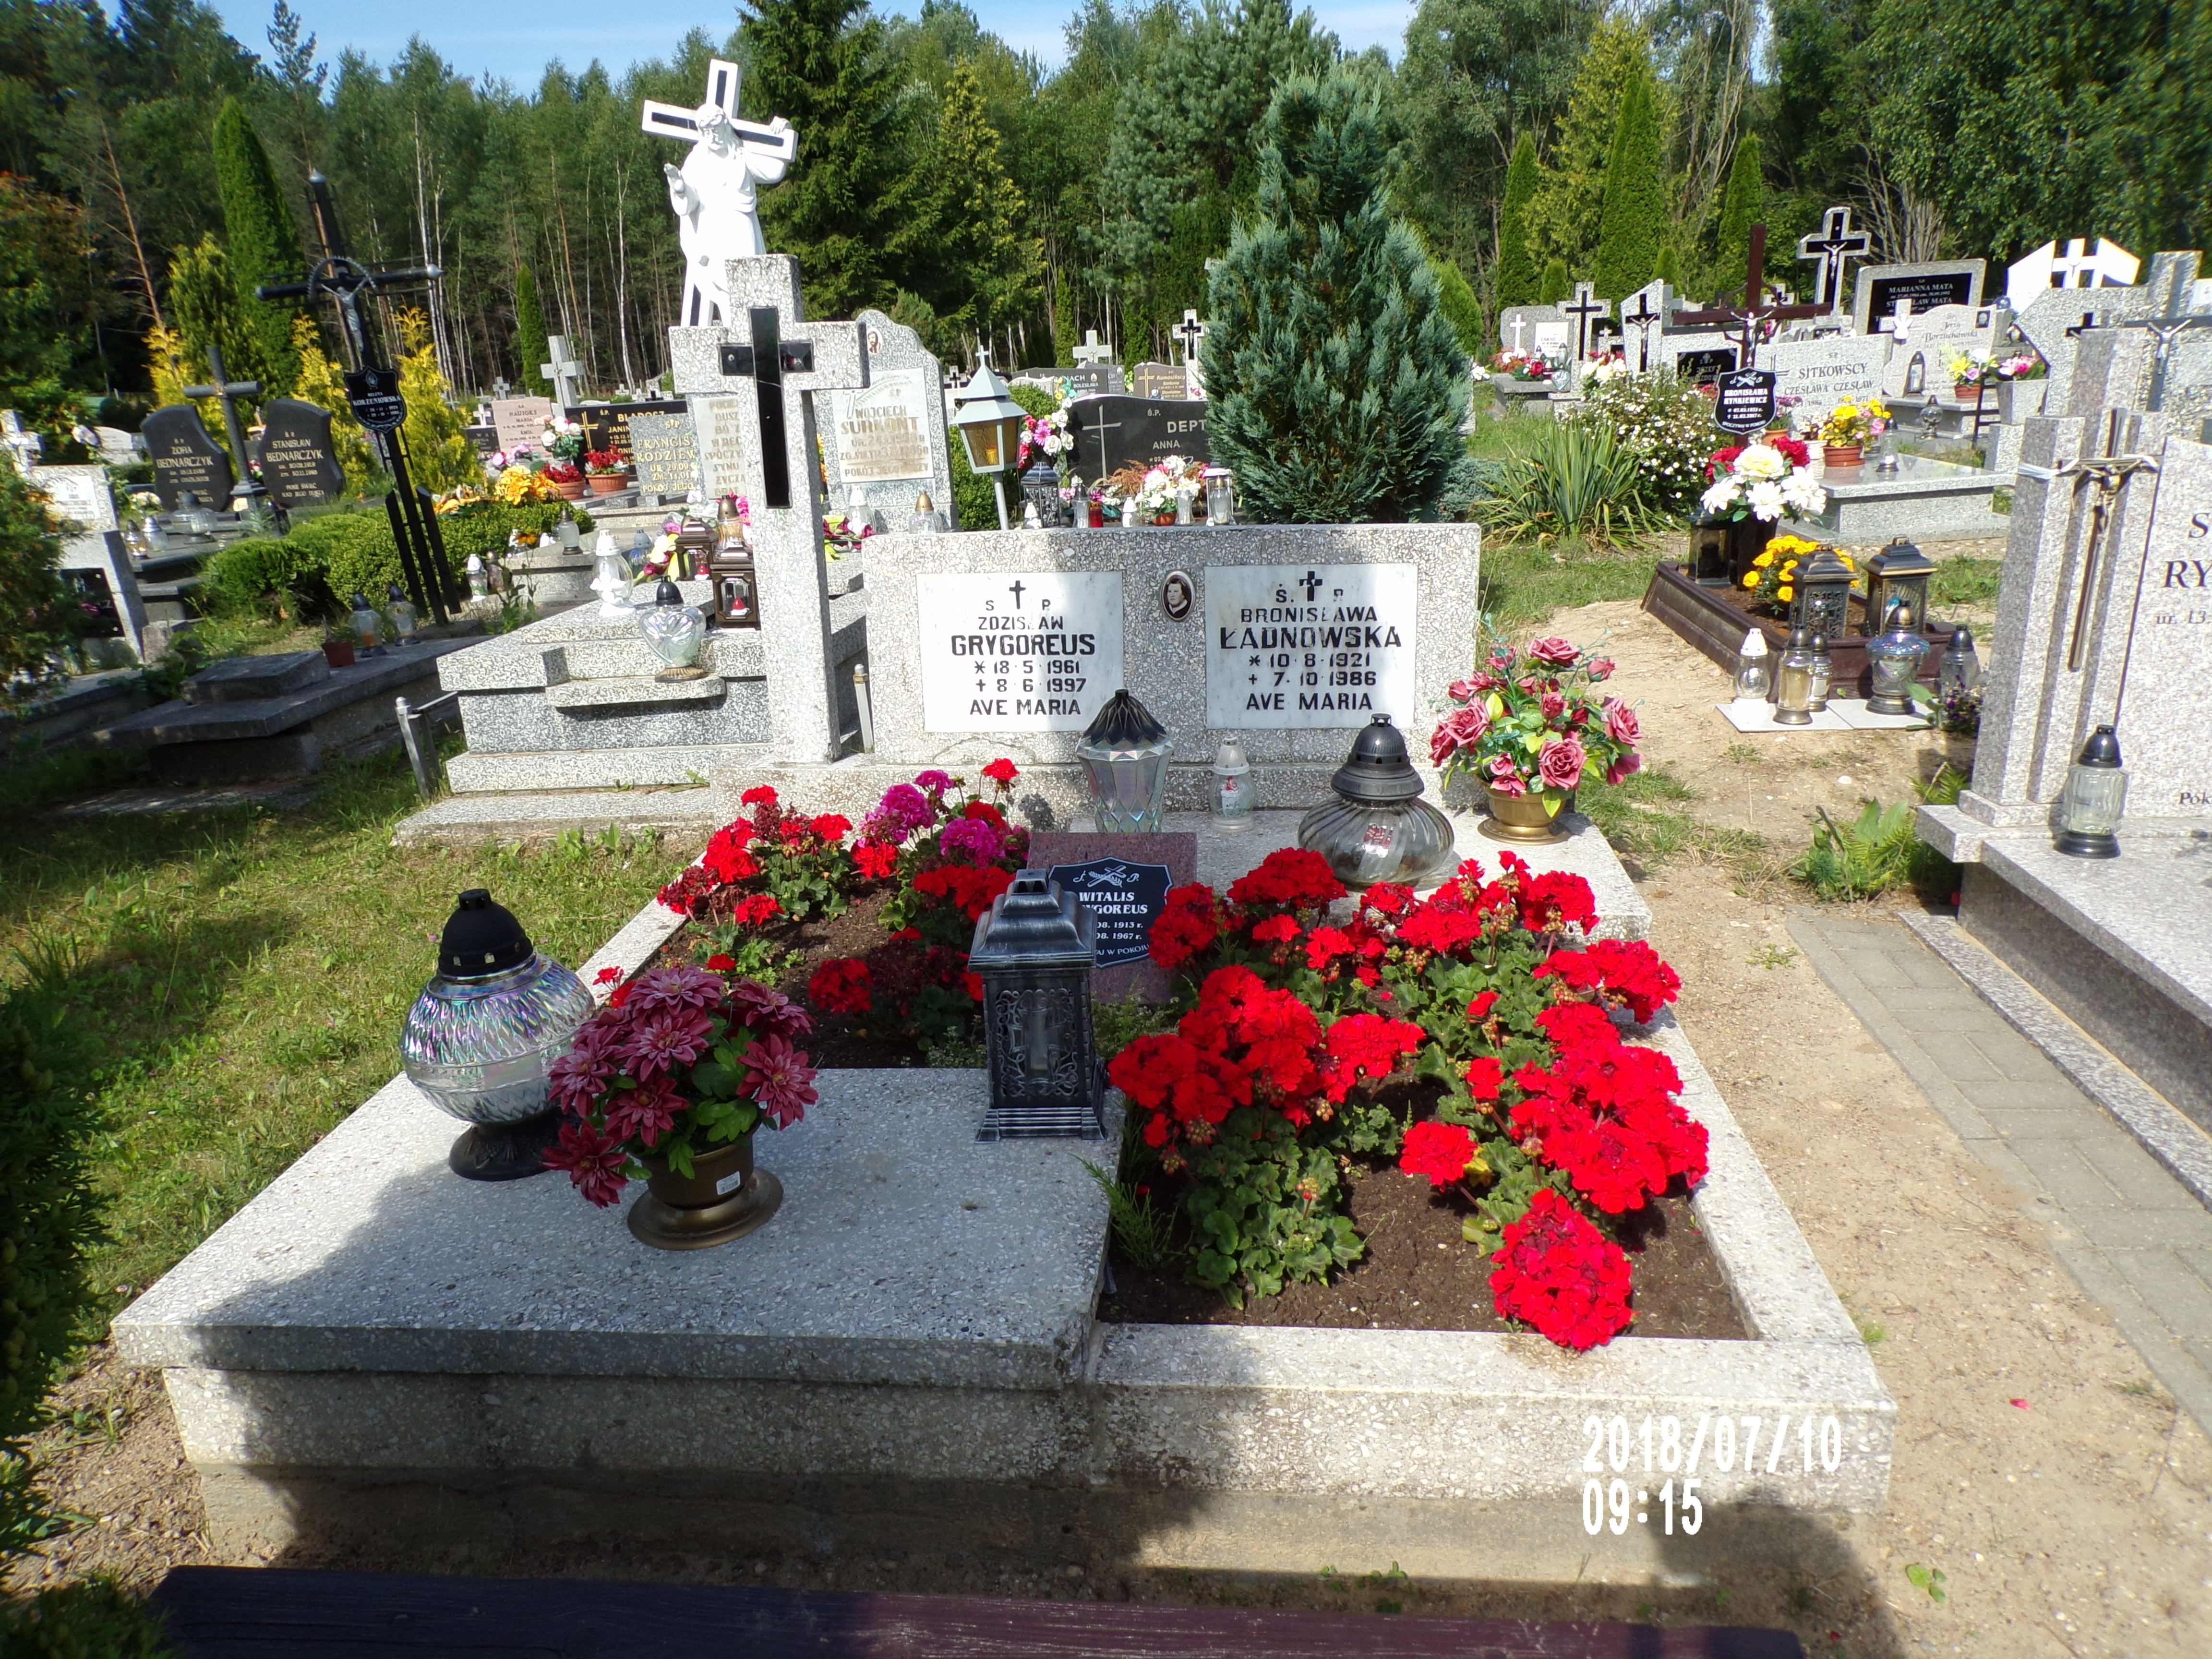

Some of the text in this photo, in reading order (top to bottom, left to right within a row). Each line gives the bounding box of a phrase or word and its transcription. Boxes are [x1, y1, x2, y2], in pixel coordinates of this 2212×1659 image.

[1888, 286, 1930, 294] MARIANNA
[1799, 362, 1867, 379] SITKOWSCY
[1724, 388, 1768, 397] BRONISŁAWA
[352, 395, 401, 406] KORZENIOWSKA
[855, 405, 907, 419] WOJCIECH
[1153, 439, 1180, 450] ANNA
[266, 449, 325, 462] BEDNARCZYK
[156, 456, 214, 469] BEDNARCZYK
[1240, 606, 1378, 623] BRONISŁAWA
[1220, 625, 1402, 649] ŁADNOWSKA
[951, 634, 1095, 656] GRYGOREUS
[969, 699, 1082, 715] AVE MARIA
[1246, 692, 1373, 710] AVE MARIA
[1079, 891, 1135, 902] WITALIS
